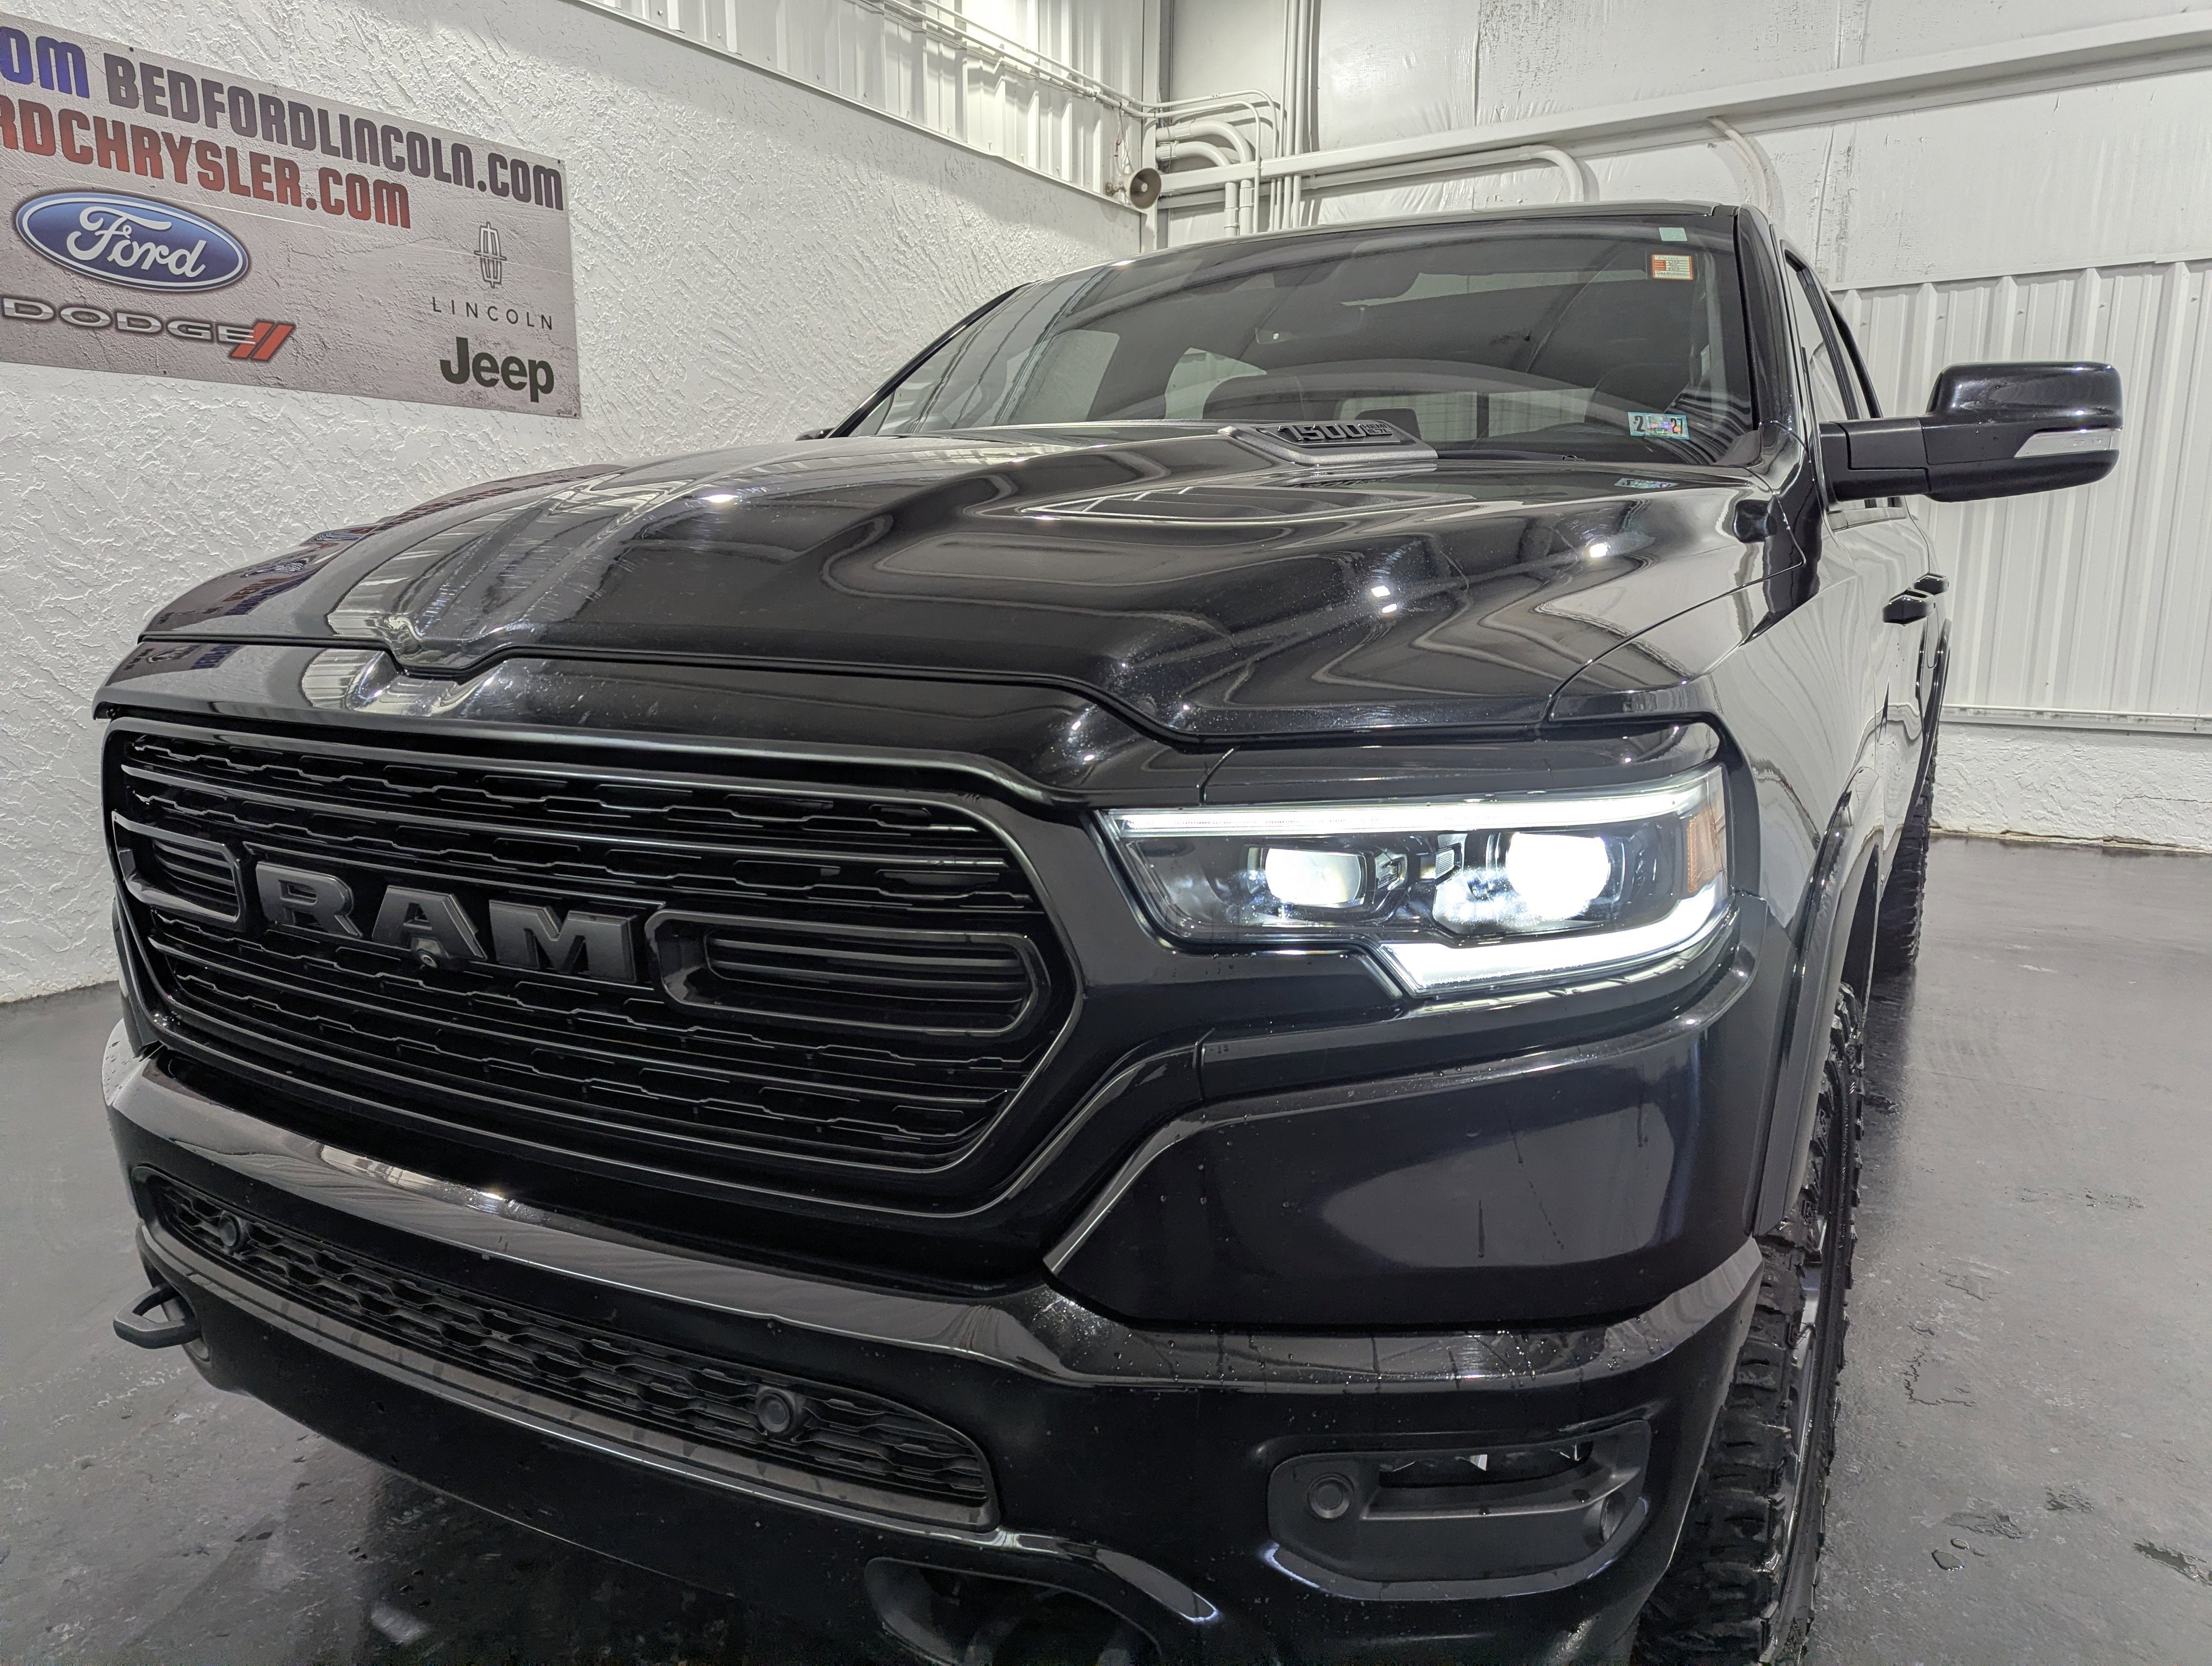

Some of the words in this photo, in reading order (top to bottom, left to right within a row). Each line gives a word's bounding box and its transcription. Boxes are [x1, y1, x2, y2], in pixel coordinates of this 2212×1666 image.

[104, 52, 564, 211] BEDFORDLINCOLN.COM
[66, 206, 206, 278] Ford
[3, 298, 256, 345] DODGE
[432, 297, 552, 330] LINCOLN
[440, 336, 554, 403] Jeep
[1277, 424, 1367, 441] 1500
[1670, 418, 1683, 434] 27
[255, 861, 638, 983] RAM
